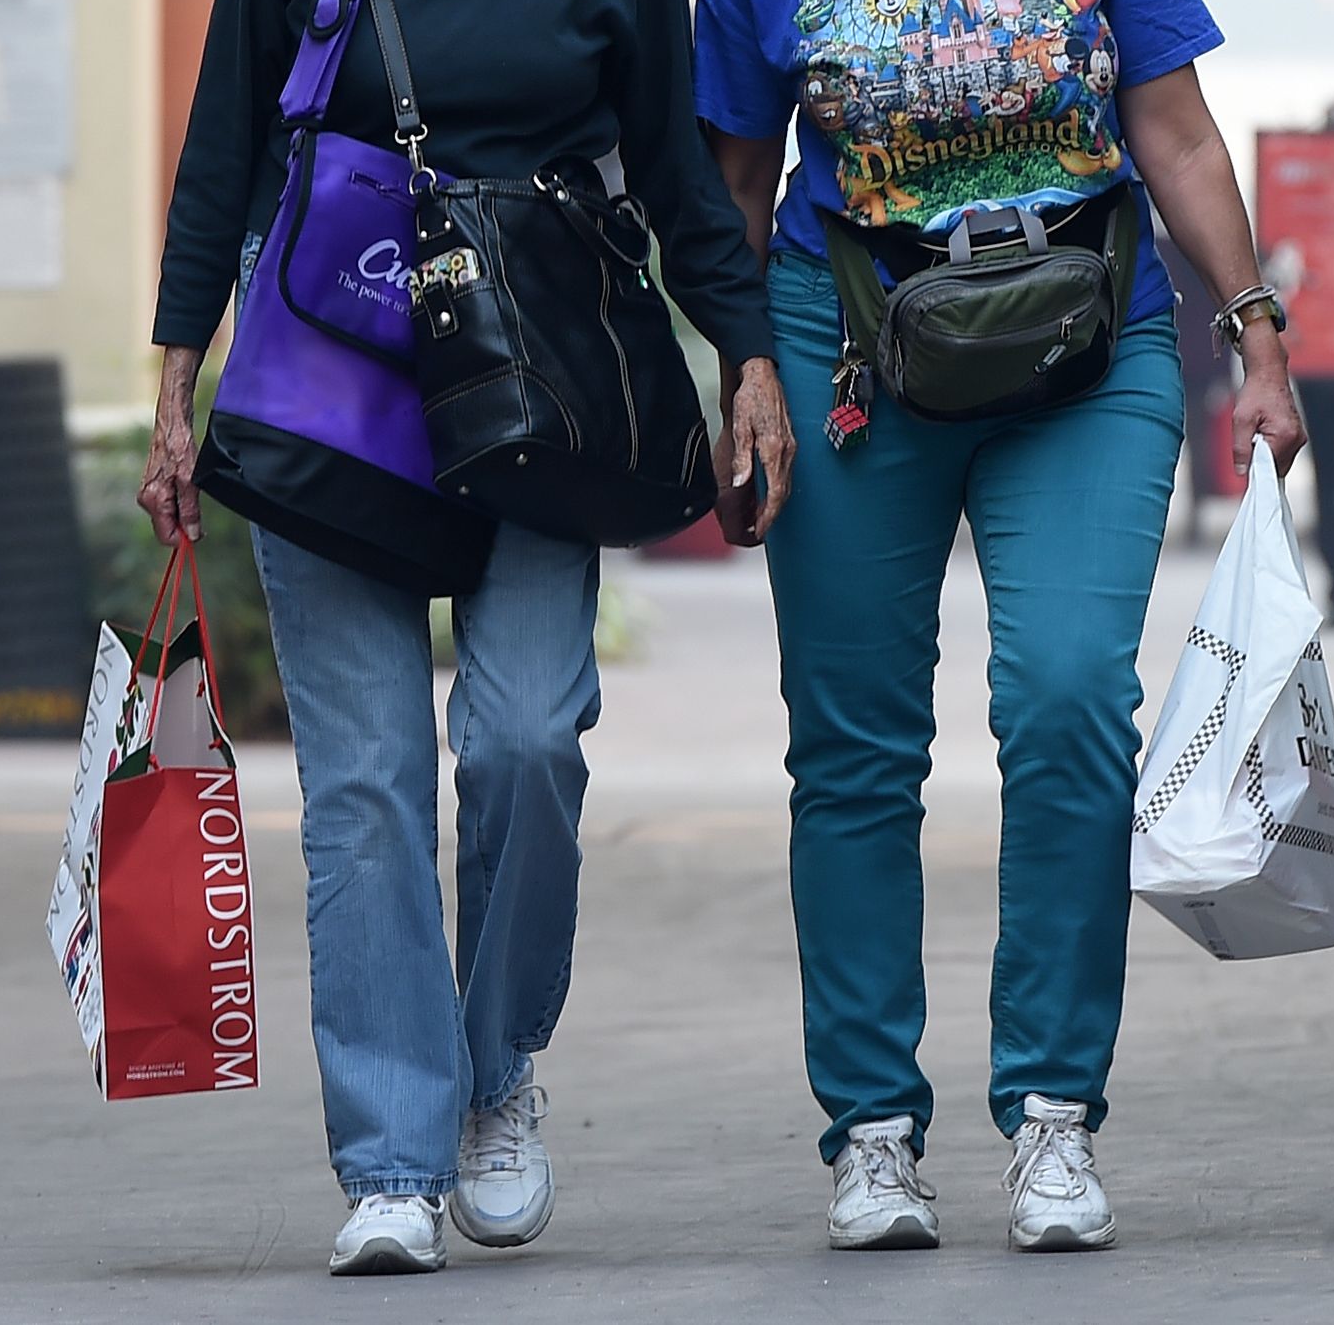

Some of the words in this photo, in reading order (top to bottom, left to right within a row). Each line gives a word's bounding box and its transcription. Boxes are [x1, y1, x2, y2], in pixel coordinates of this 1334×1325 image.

[848, 109, 1080, 191] Disneyland
[338, 269, 358, 291] The
[358, 285, 392, 307] power
[393, 301, 405, 314] to
[195, 772, 254, 1089] NORDSTROM
